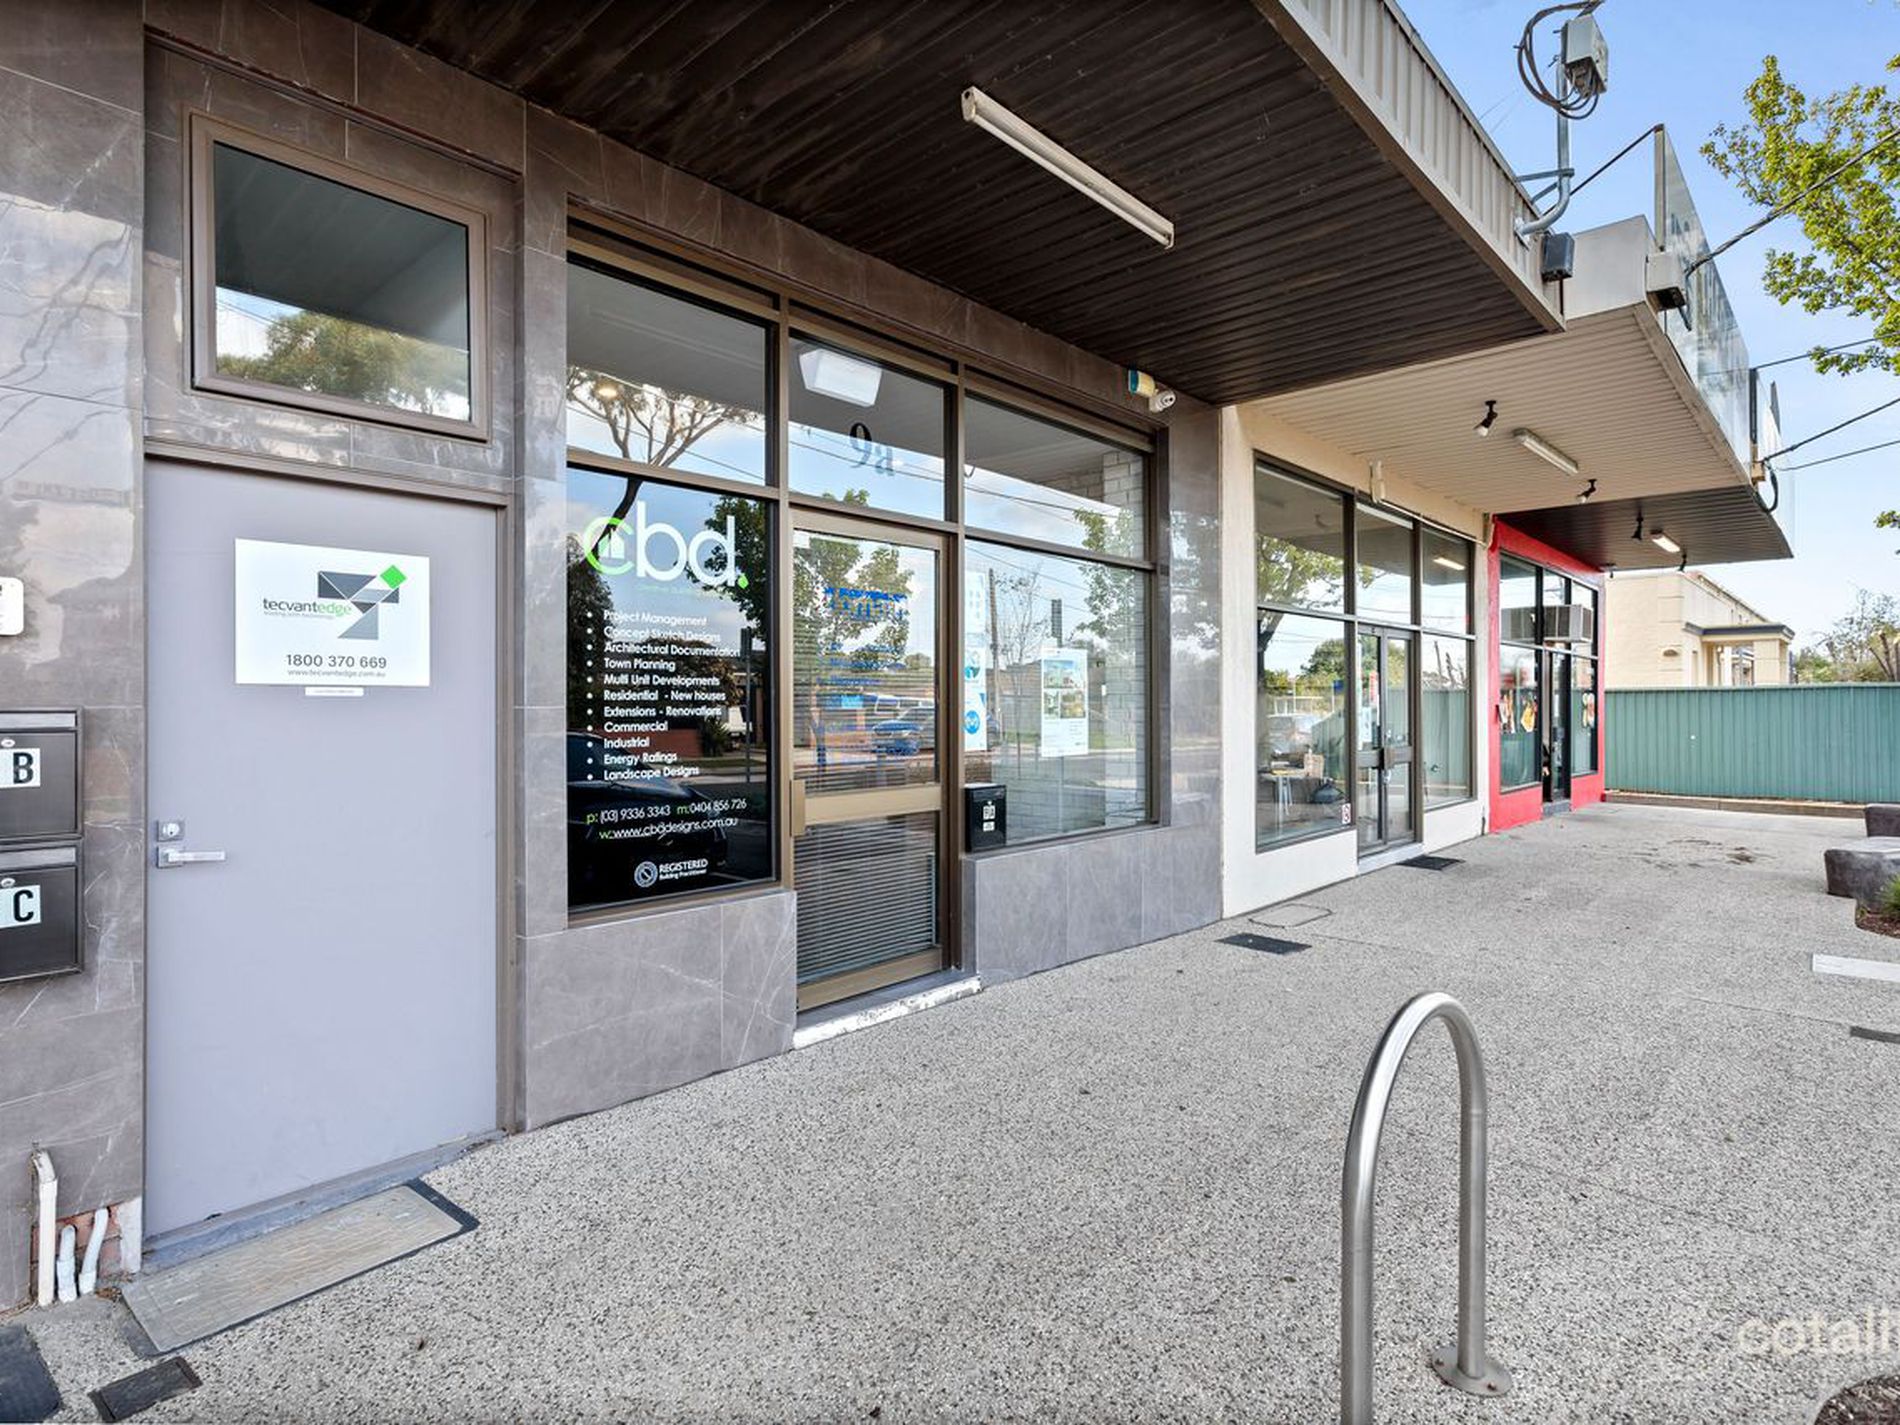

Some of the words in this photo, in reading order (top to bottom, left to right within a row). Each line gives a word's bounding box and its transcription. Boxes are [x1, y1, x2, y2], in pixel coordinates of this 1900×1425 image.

[263, 597, 352, 617] tecvantedge
[604, 609, 640, 624] Project
[641, 611, 707, 626] Management
[604, 626, 649, 640] Concept
[650, 628, 685, 641] Sketch
[686, 631, 721, 643] Designs
[604, 641, 669, 655] Architectural
[671, 645, 741, 657] Documentation
[286, 654, 323, 667] 1800
[328, 655, 354, 668] 370
[359, 656, 387, 669] 669
[604, 658, 632, 669] Town
[633, 658, 676, 672] Planning
[604, 674, 629, 685] Multi
[631, 674, 650, 685] Unit
[652, 675, 720, 687] Developments
[604, 690, 659, 701] Residential
[671, 690, 692, 701] New
[694, 690, 726, 701] houses
[604, 706, 657, 717] Extensions
[666, 706, 722, 716] Renovations
[604, 721, 669, 733] Commercial
[604, 737, 650, 749] Industrial
[604, 753, 639, 766] Energy
[642, 751, 678, 764] Ratings
[13, 752, 34, 784] B
[604, 768, 661, 782] Landscape
[663, 765, 700, 777] Designs
[620, 807, 645, 820] 9336
[731, 798, 747, 810] 726
[658, 858, 709, 873] REGISTERED
[12, 890, 34, 922] C
